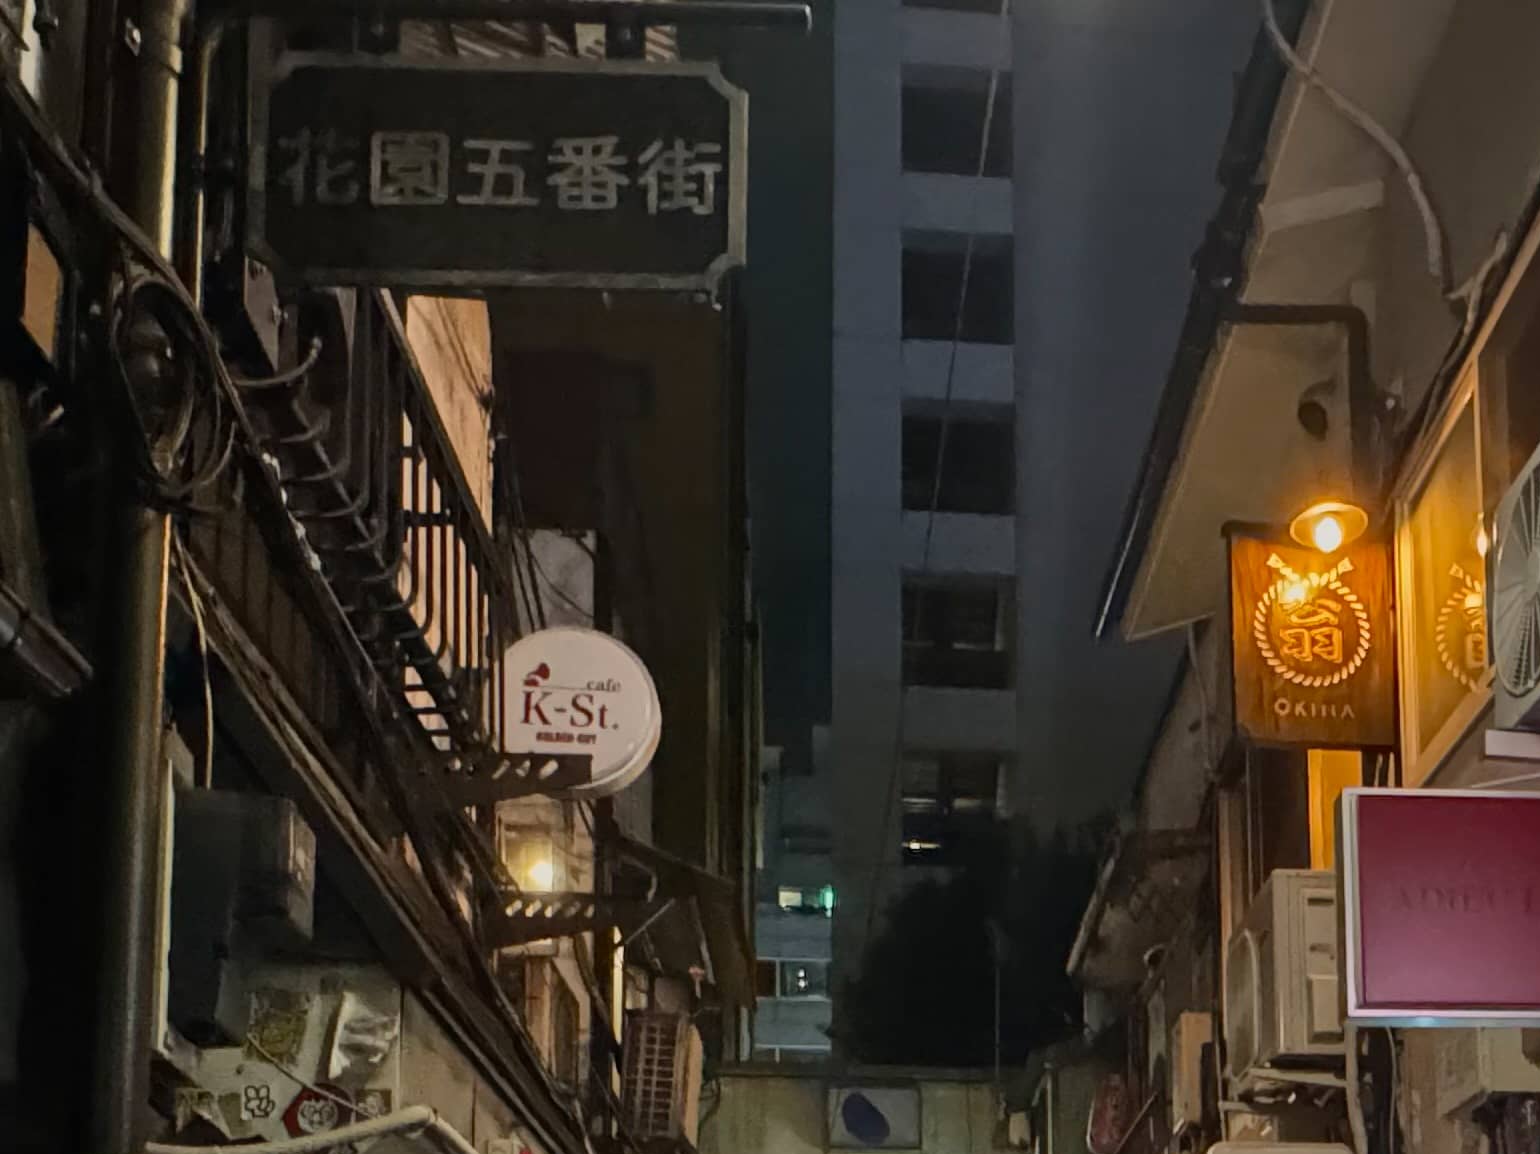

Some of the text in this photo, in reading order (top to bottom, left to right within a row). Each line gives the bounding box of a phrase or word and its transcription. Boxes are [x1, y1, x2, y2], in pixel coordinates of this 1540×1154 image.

[278, 128, 722, 214] 花園五番街
[586, 679, 622, 692] cafe
[520, 690, 619, 730] K-St.
